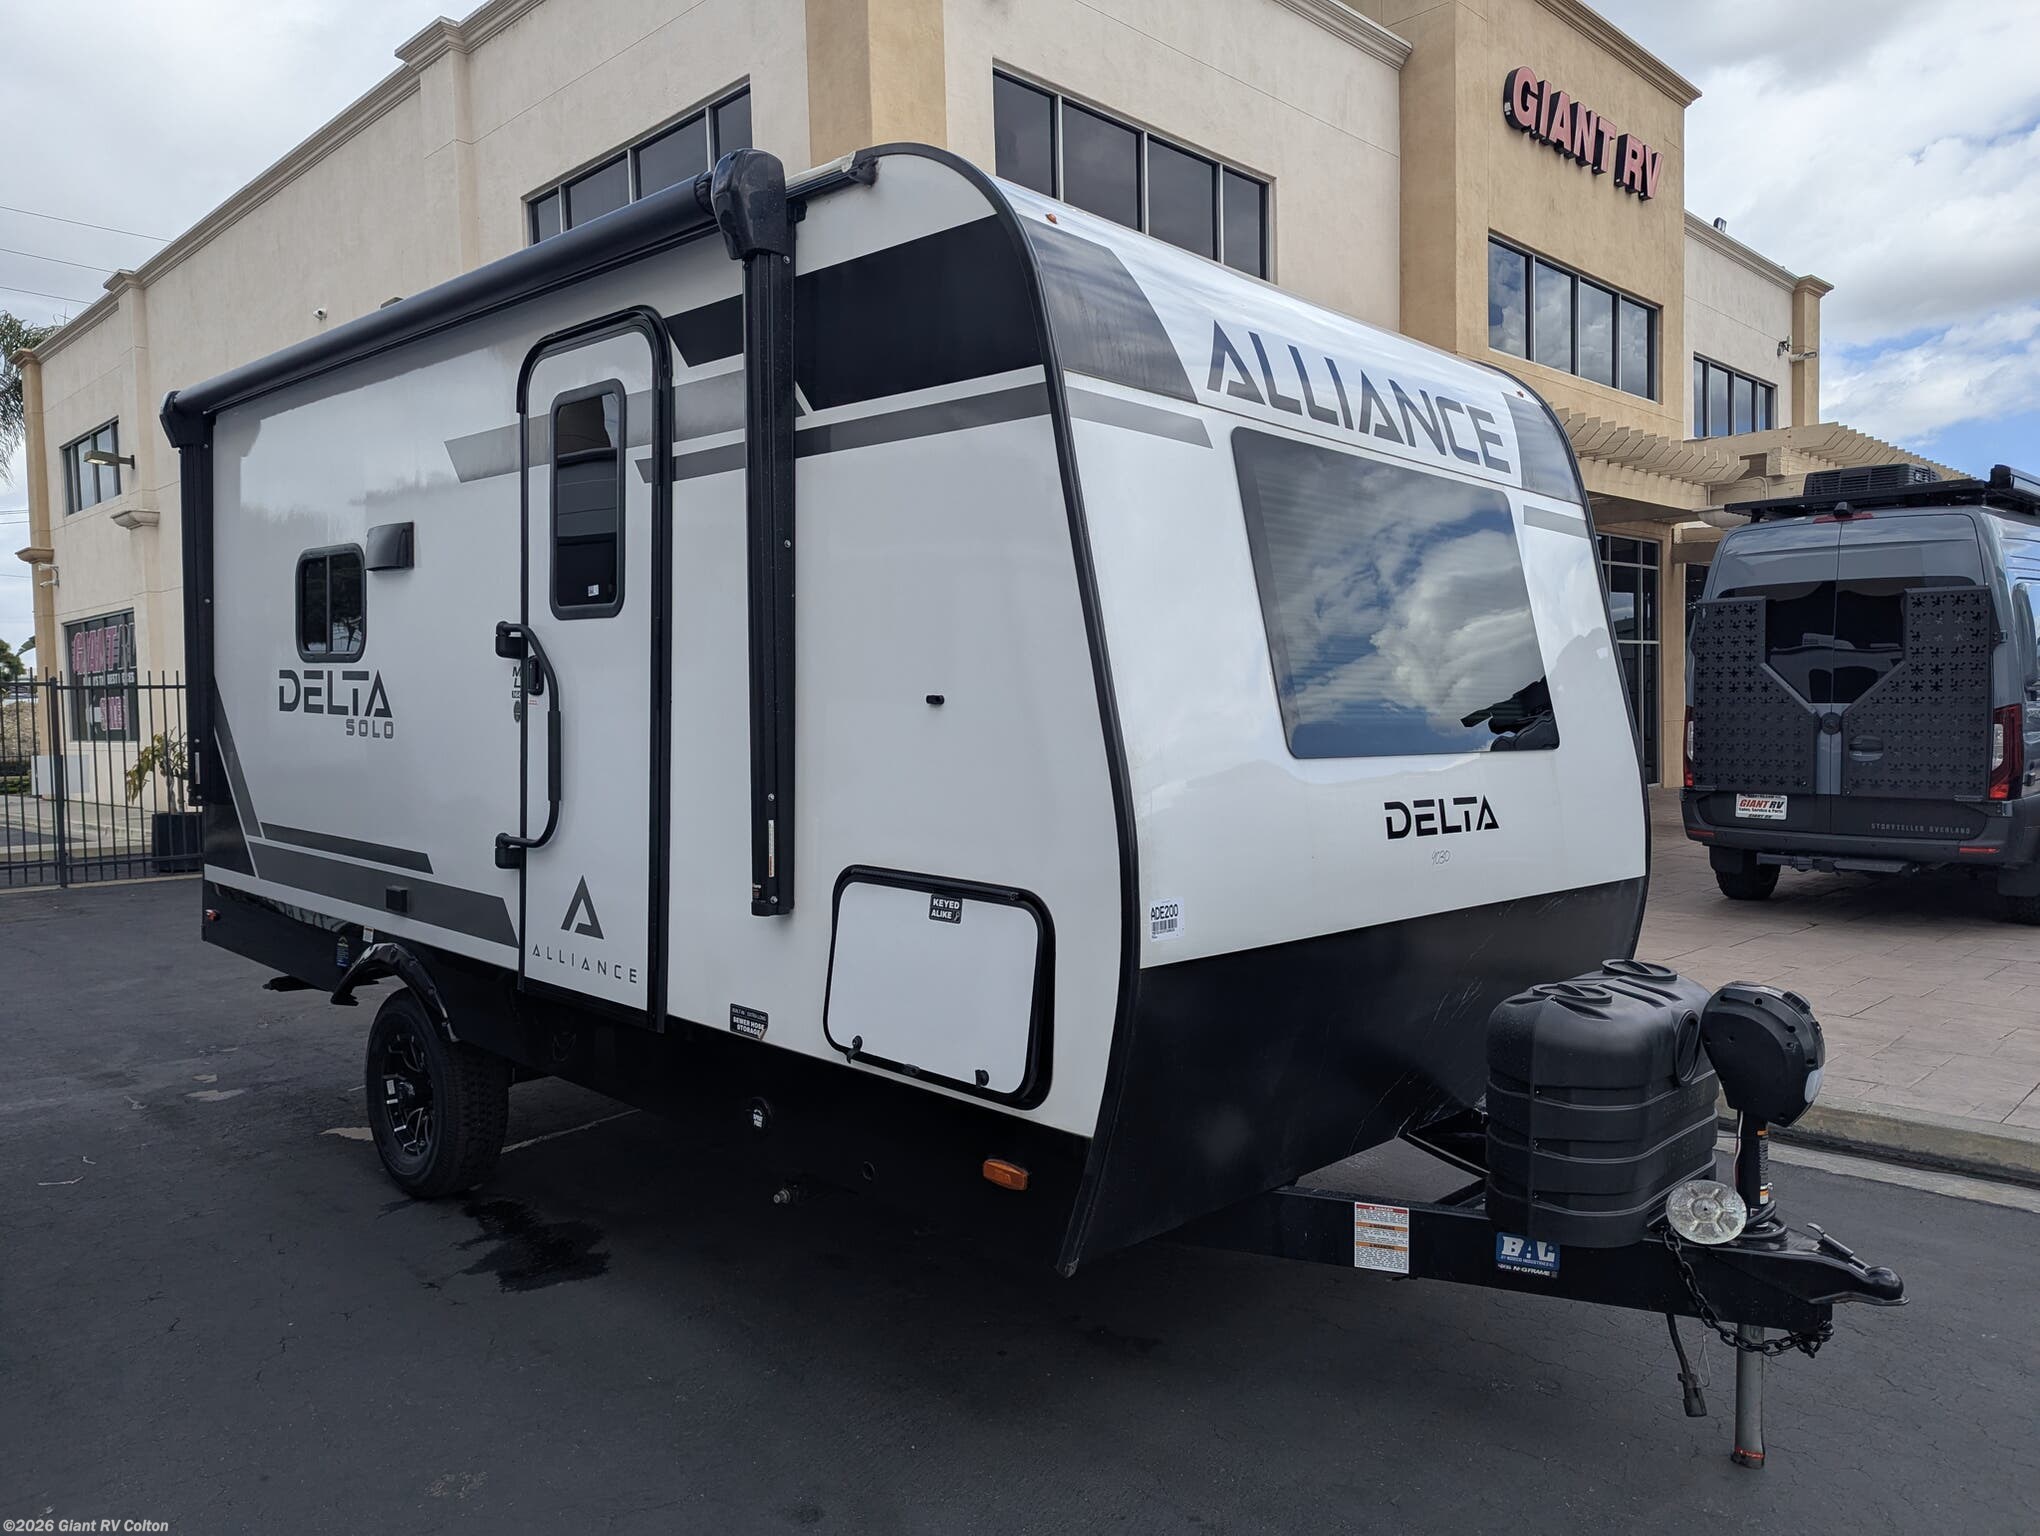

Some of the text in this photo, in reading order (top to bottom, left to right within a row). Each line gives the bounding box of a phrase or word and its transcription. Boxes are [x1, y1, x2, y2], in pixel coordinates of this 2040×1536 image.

[1503, 66, 1664, 200] GIANT RV
[1207, 320, 1511, 474] ALLIANCE
[279, 669, 393, 718] DELTA
[346, 719, 394, 739] SOLO
[1384, 795, 1499, 839] DELTA
[1740, 799, 1784, 809] GIANT RV
[931, 909, 953, 919] ALIKE
[933, 898, 960, 909] KEYED
[533, 944, 637, 983] ALLIANCE
[1502, 1236, 1555, 1262] BAL
